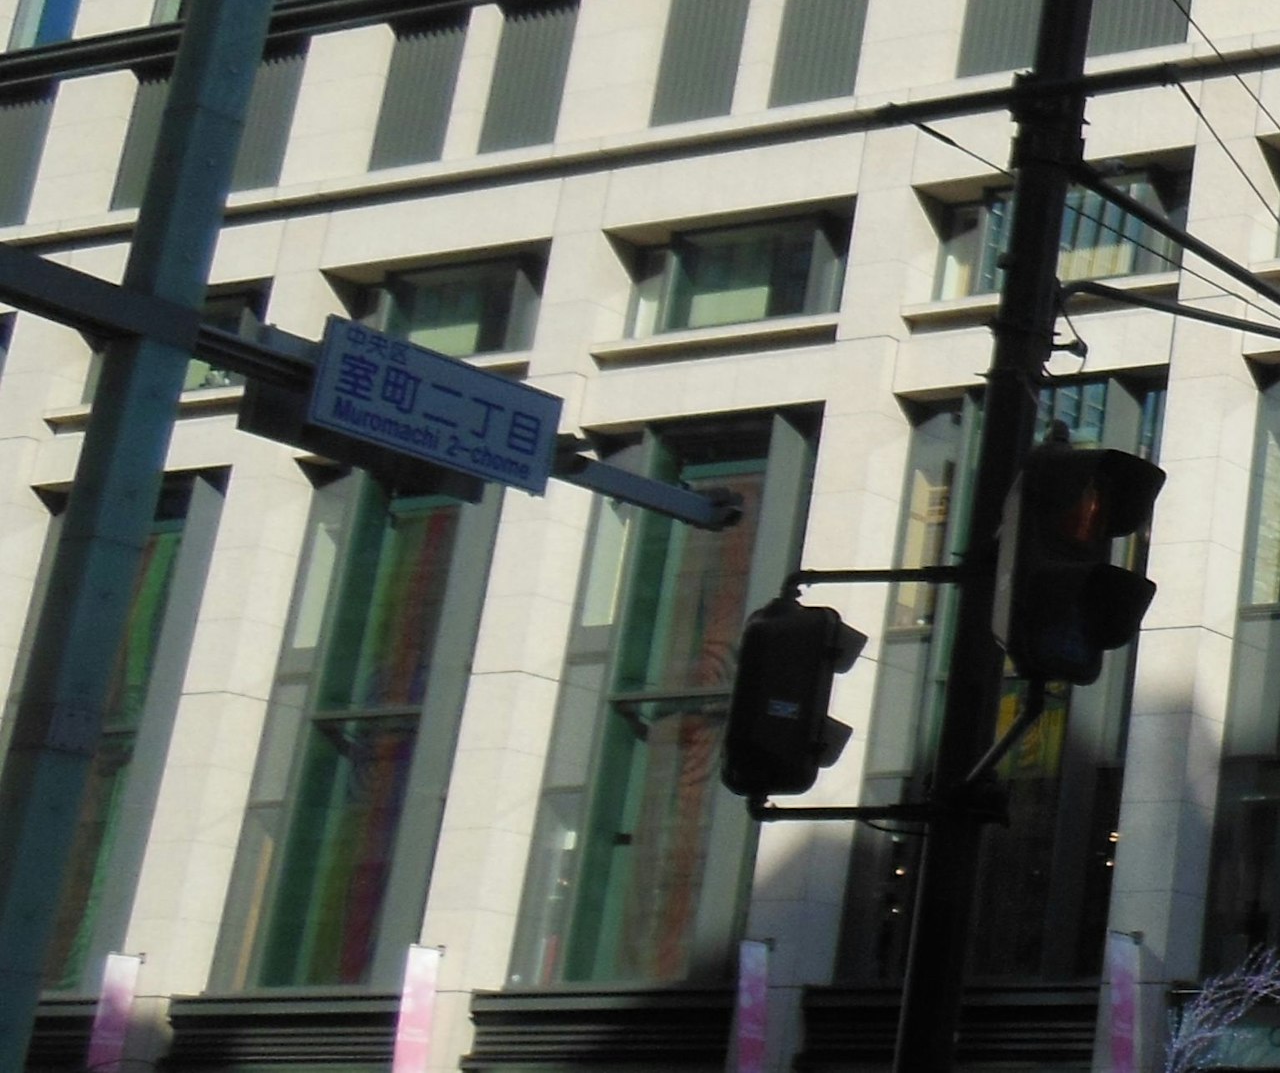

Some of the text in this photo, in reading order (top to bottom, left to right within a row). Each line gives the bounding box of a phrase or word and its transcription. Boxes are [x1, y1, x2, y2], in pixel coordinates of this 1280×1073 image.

[346, 326, 410, 366] 中央区
[333, 396, 531, 478] Muromachi 2-chome
[334, 352, 542, 456] 室町二丁目
